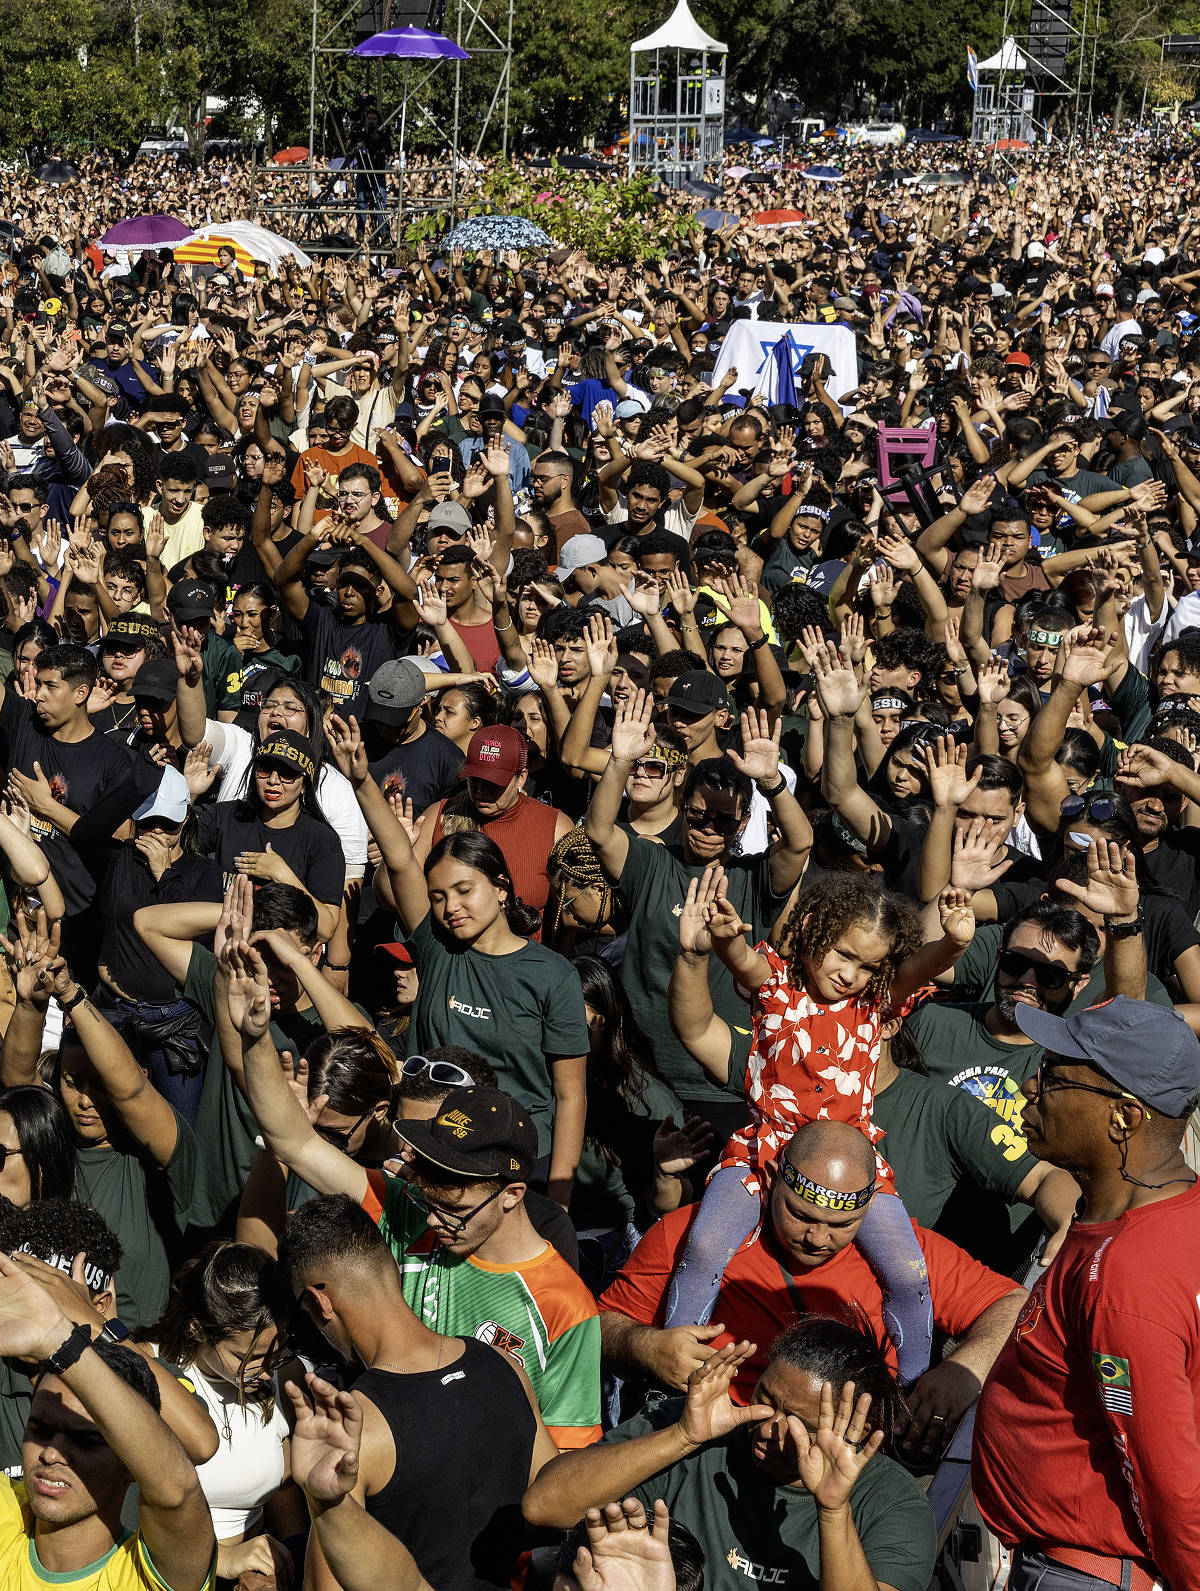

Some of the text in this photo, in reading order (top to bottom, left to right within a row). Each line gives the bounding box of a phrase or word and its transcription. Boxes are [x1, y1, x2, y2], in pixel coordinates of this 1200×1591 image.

[1029, 630, 1064, 646] ESU
[264, 741, 315, 777] JESUS
[983, 1065, 1010, 1079] PARA
[446, 1108, 473, 1127] NIKE
[452, 1127, 468, 1140] SB
[793, 1181, 857, 1211] JESUS
[796, 1172, 858, 1201] MARCHA
